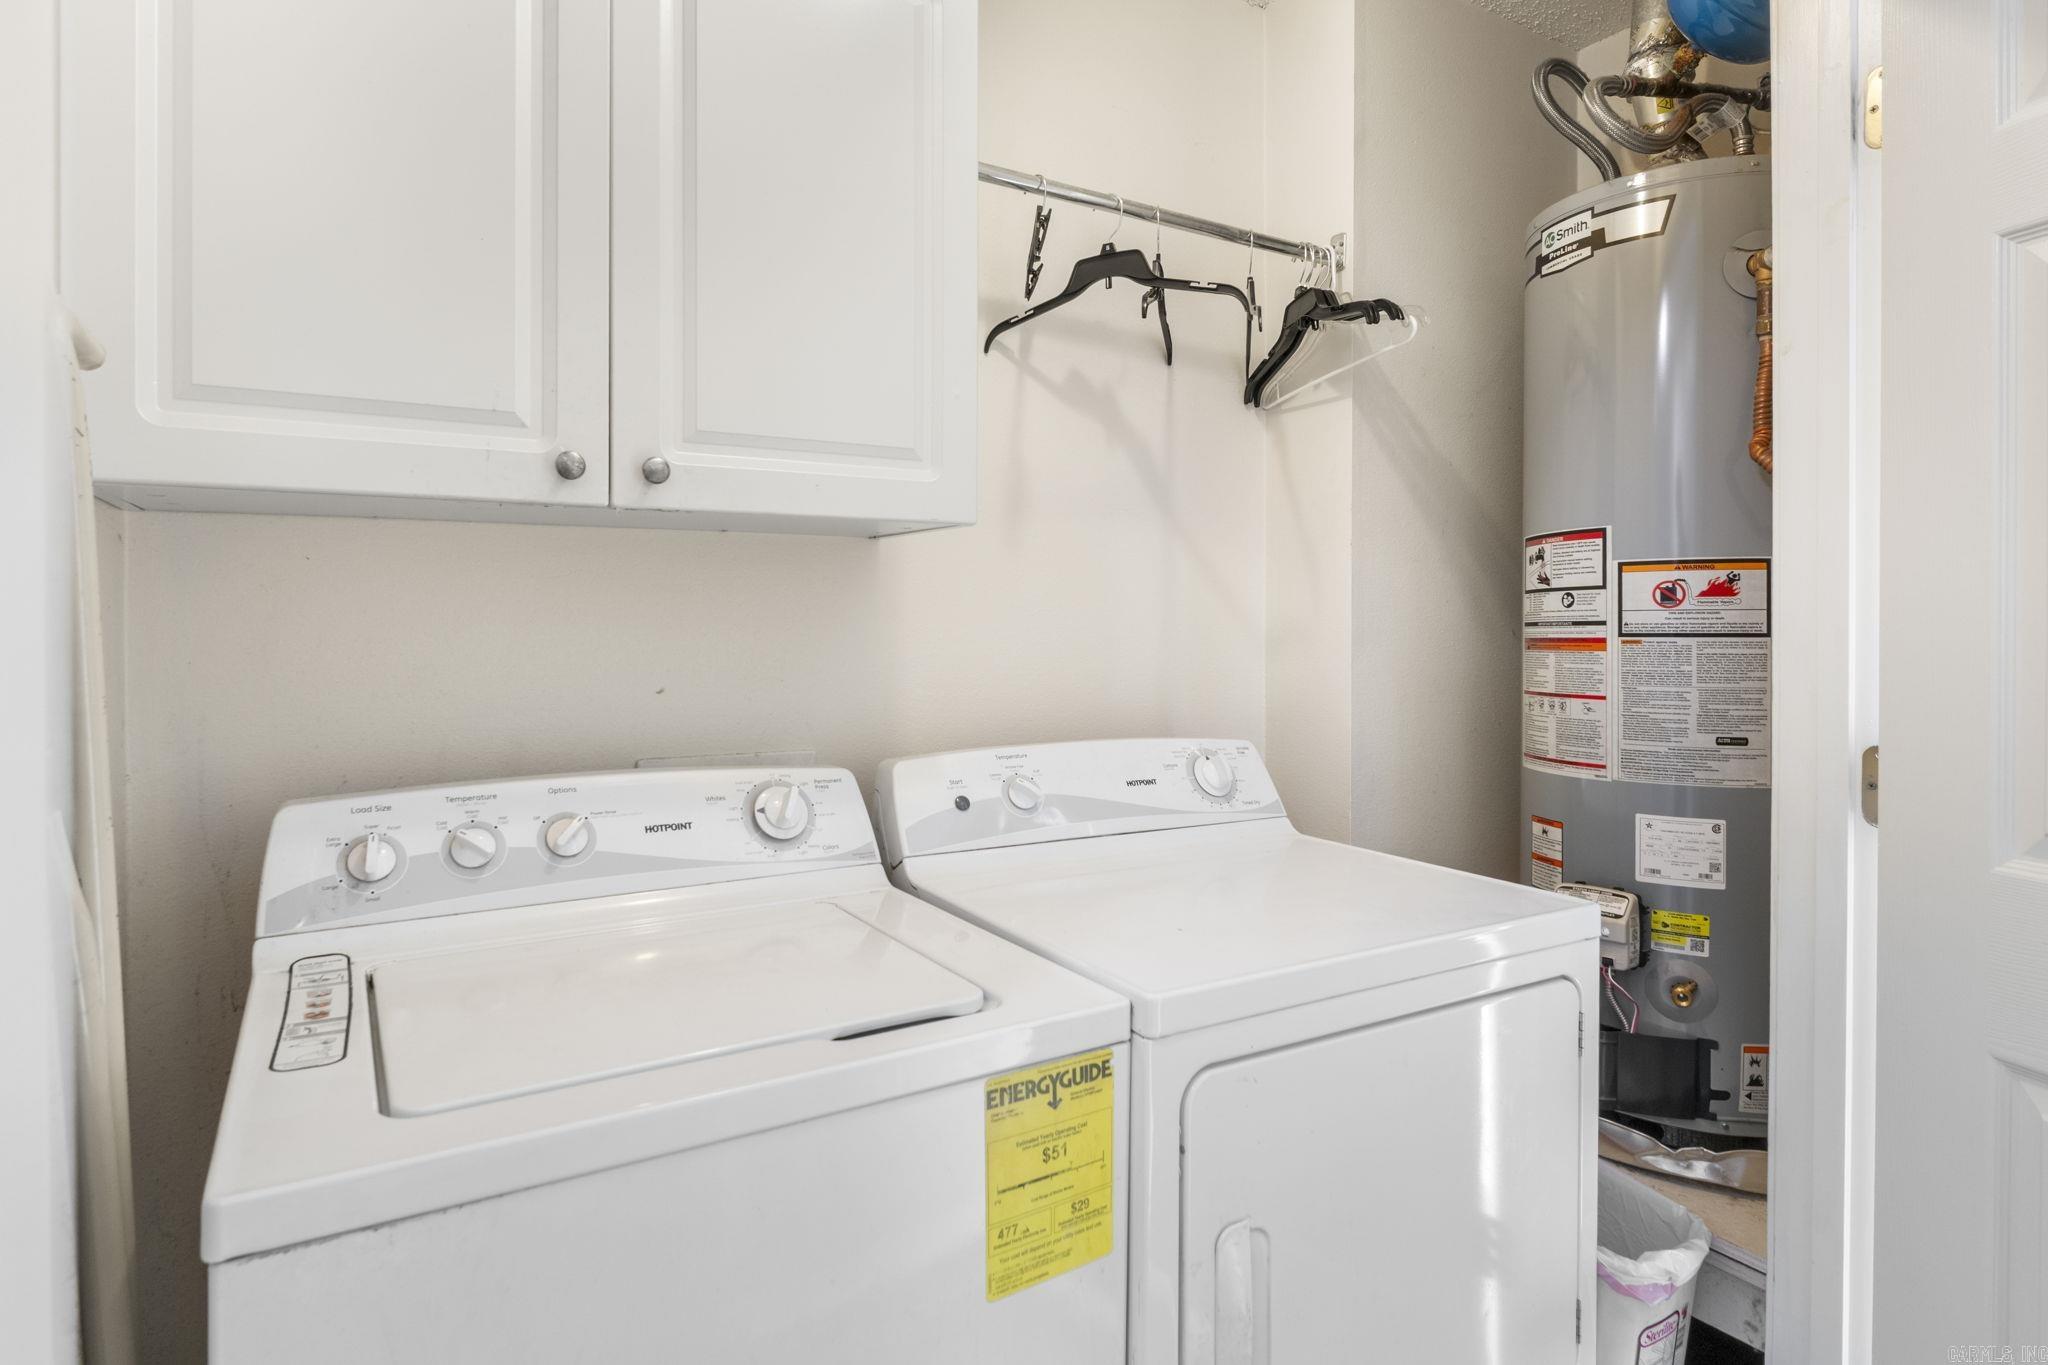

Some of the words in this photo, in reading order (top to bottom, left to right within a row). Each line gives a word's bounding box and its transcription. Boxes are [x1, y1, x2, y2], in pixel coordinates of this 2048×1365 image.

[1557, 220, 1588, 241] Smith
[1549, 243, 1578, 260] ProLine
[995, 753, 1028, 761] Temperature
[813, 777, 842, 785] Permanent
[1126, 778, 1157, 788] HOTPOINT
[547, 786, 577, 795] Options
[445, 794, 498, 804] Temperature
[350, 805, 373, 815] Load
[374, 803, 392, 813] Size
[644, 821, 693, 834] HOTPOINT
[822, 843, 839, 851] Colors
[986, 1058, 1112, 1110] ENERGYGUIDE
[1042, 1142, 1068, 1164] $51
[1071, 1198, 1090, 1215] $29
[998, 1223, 1018, 1240] 477
